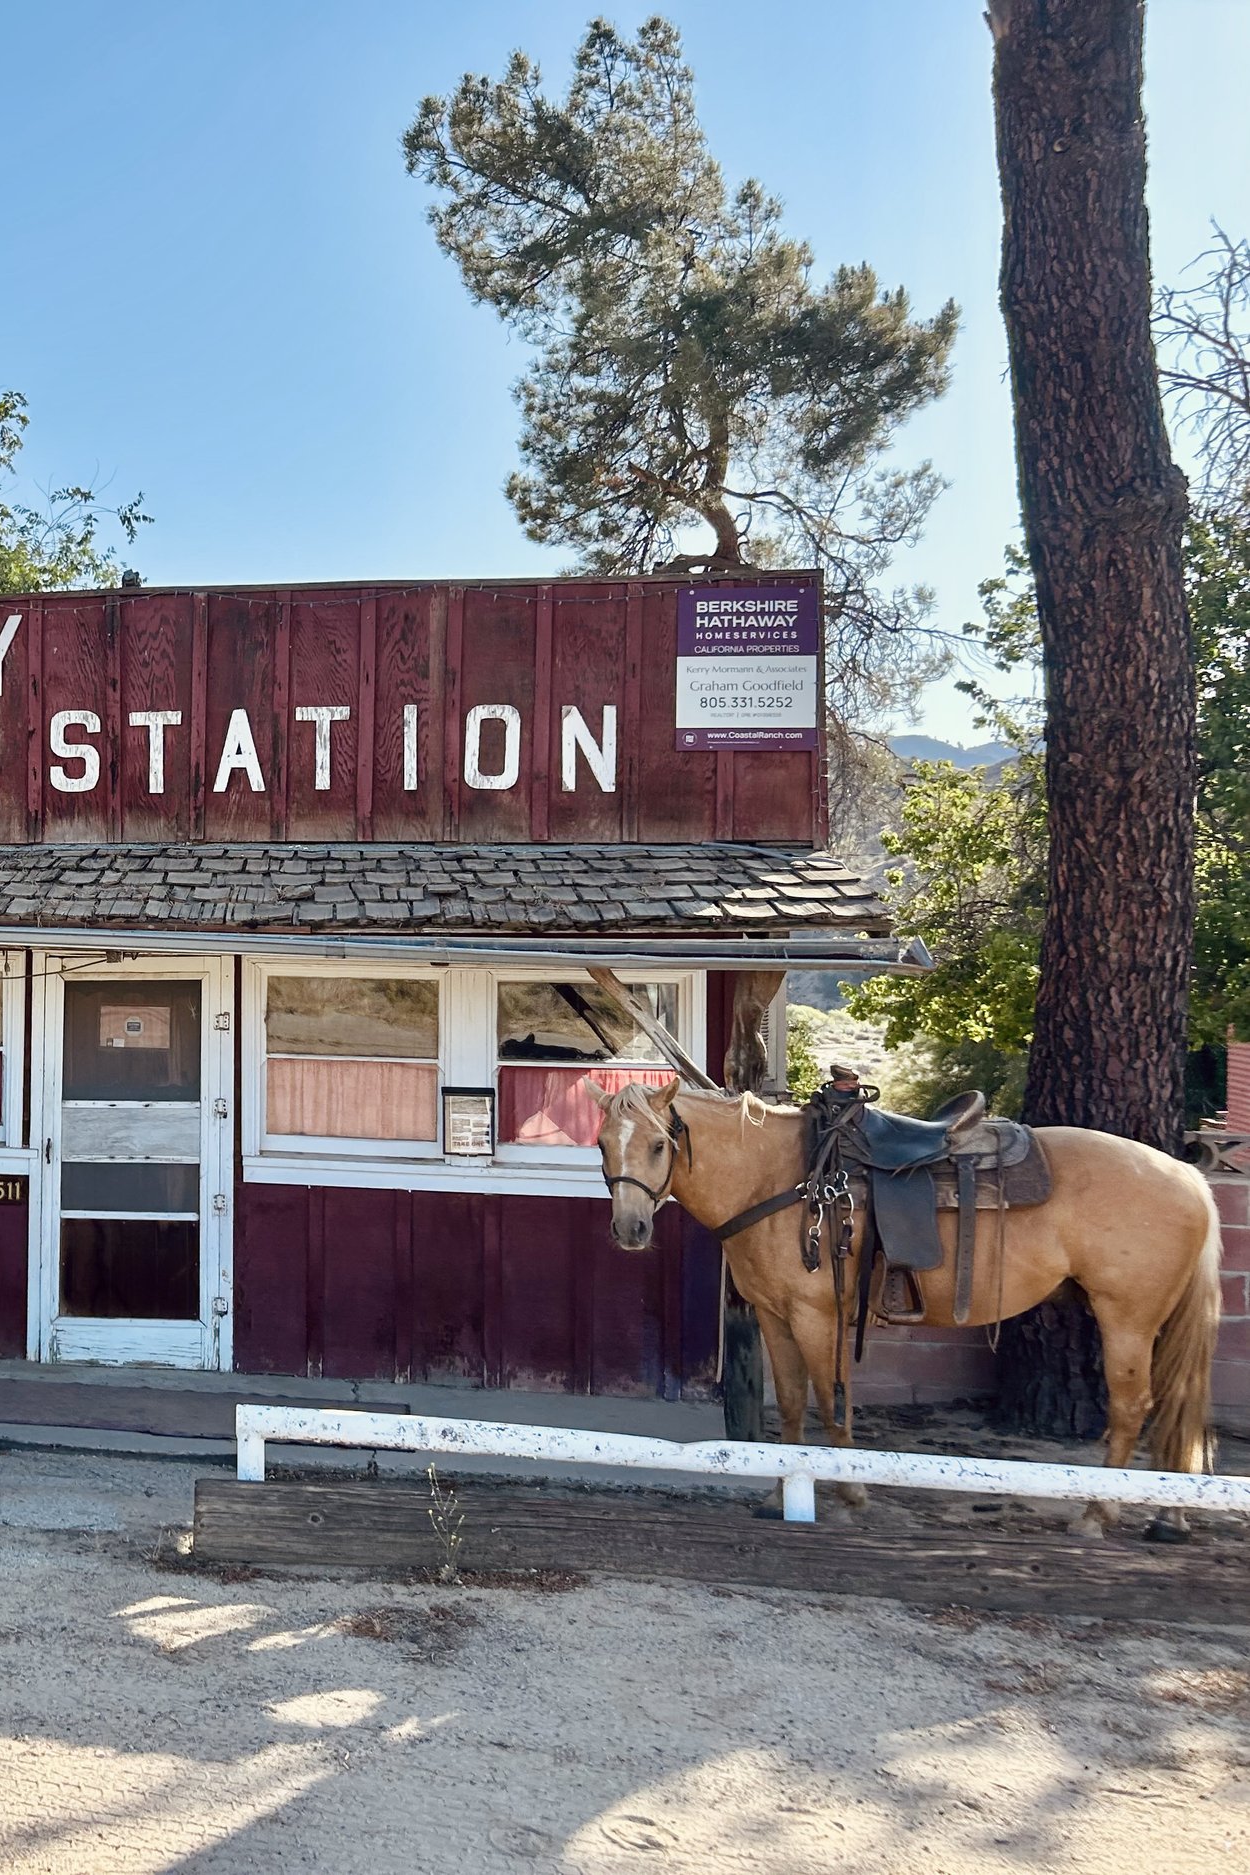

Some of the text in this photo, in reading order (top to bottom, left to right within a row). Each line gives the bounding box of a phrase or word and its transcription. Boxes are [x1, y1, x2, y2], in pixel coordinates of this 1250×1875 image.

[696, 600, 799, 613] BERKSHIRE
[696, 615, 798, 628] HATHAWAY
[695, 631, 798, 640] HOMESERVICES
[694, 644, 800, 654] CALIFORNIA PROPERTIES
[686, 665, 807, 675] Kerry Mormann & Associates
[690, 679, 804, 692] Graham Goodfield
[699, 696, 793, 709] 805.331.5252
[707, 731, 803, 739] www.CoastalRanch.com
[49, 703, 617, 795] STATION
